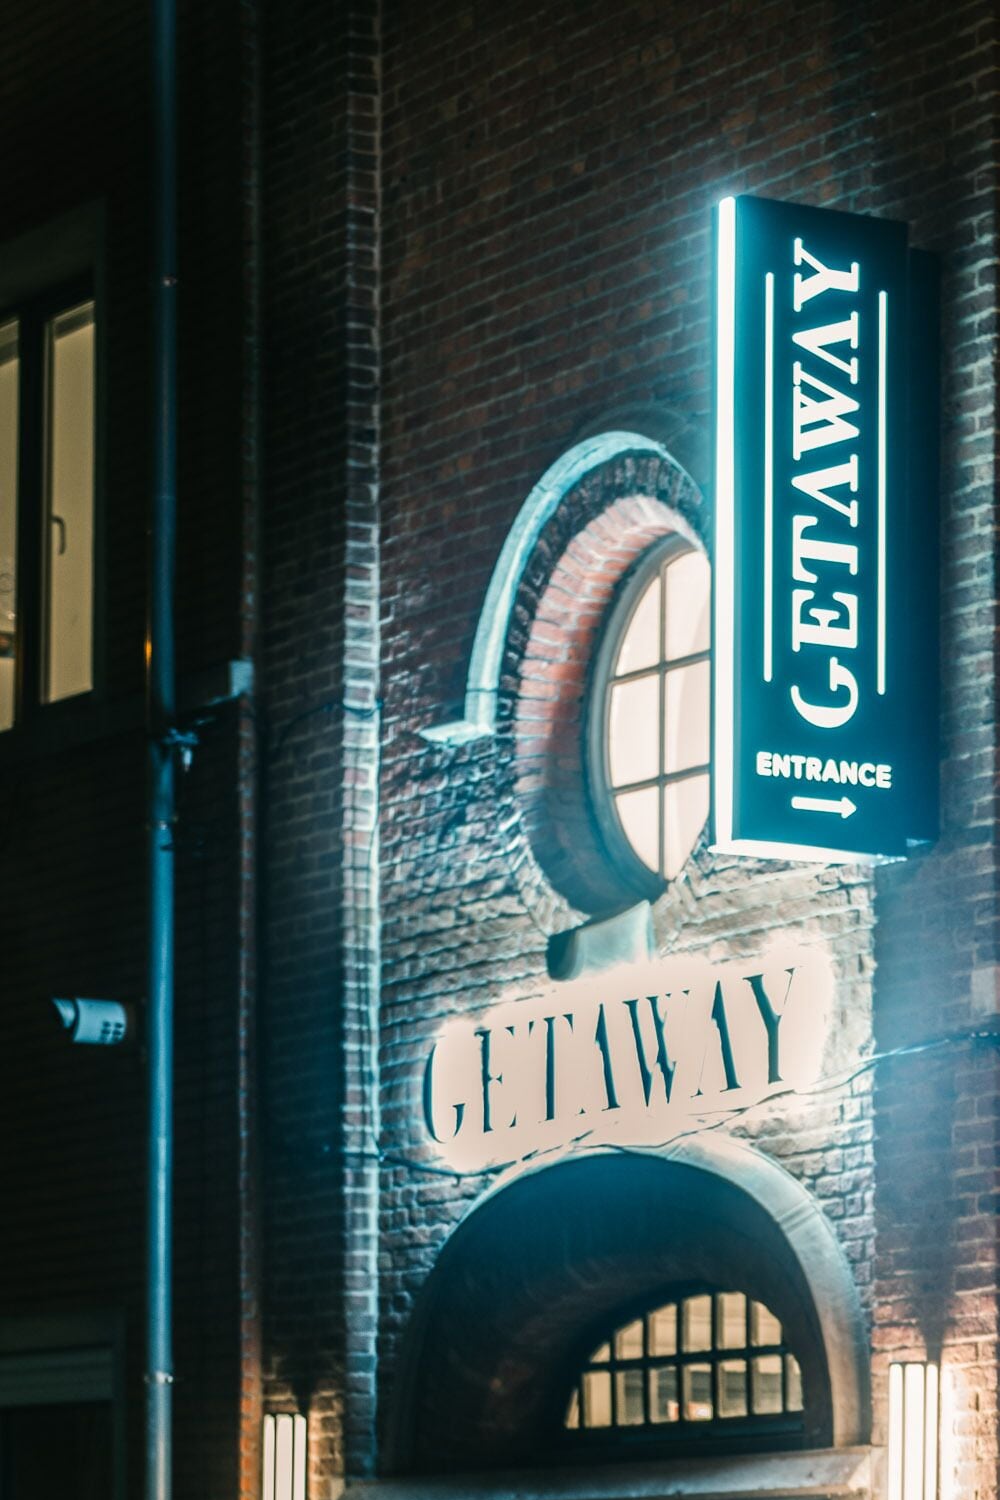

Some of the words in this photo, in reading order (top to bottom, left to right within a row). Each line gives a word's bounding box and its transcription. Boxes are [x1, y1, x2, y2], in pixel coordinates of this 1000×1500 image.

[791, 236, 860, 729] GETAWAY
[755, 751, 893, 789] ENTRANCE
[422, 966, 801, 1144] GETAWAY
